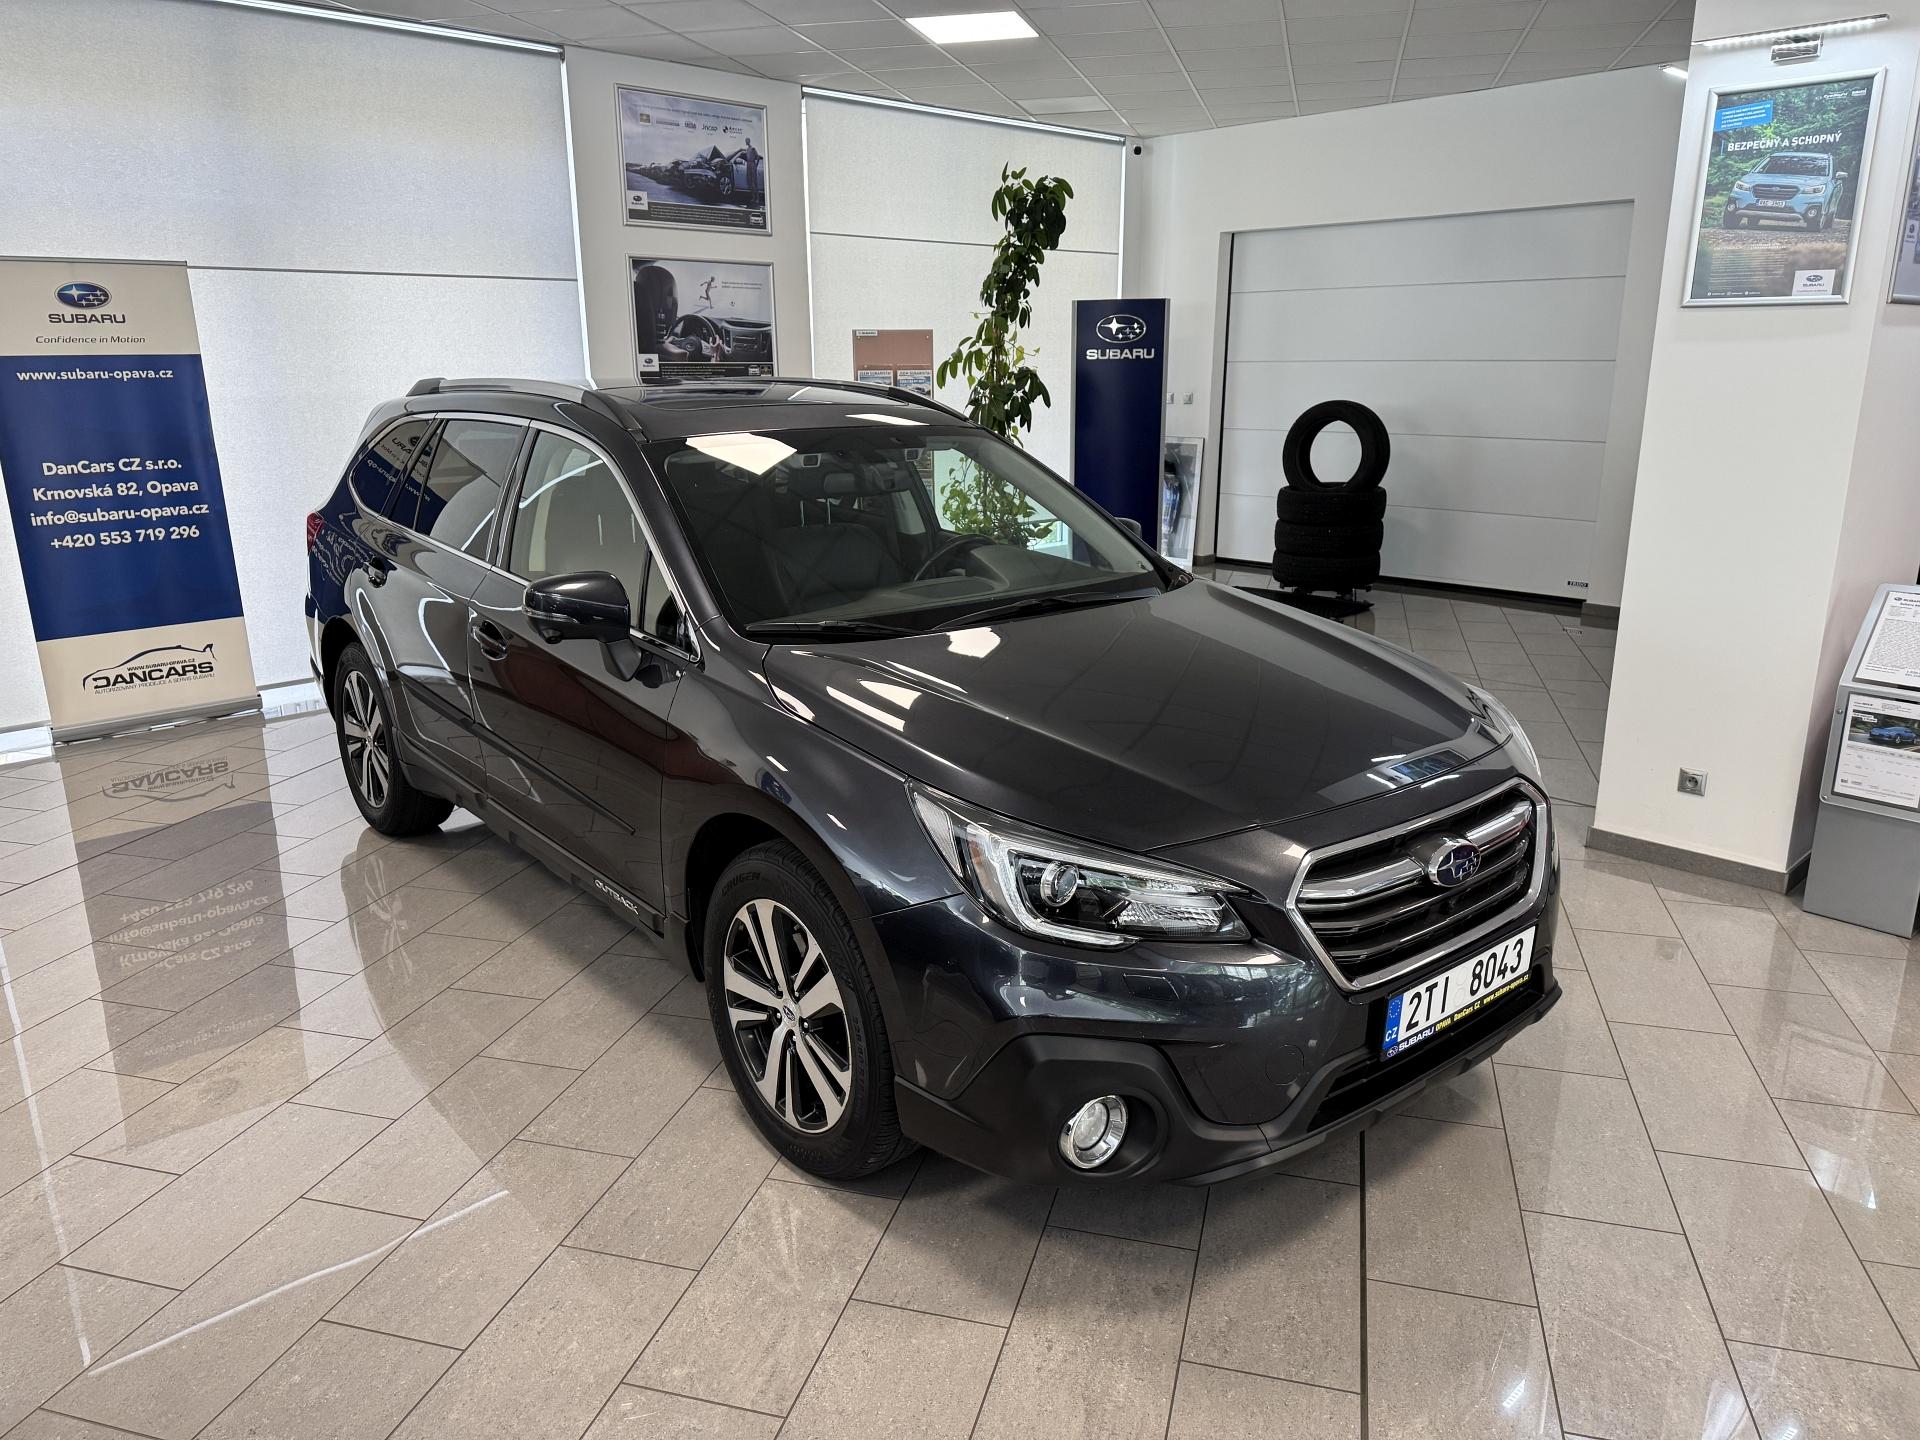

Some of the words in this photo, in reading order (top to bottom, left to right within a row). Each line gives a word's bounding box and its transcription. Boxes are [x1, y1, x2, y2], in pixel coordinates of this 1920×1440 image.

[1727, 136, 1781, 152] BEZPEČNÝ
[1781, 138, 1790, 147] A
[1791, 129, 1842, 146] SCHOPNÝ
[48, 313, 126, 324] SUBARU
[35, 335, 97, 344] Confidence
[99, 335, 108, 344] in
[110, 335, 146, 344] Motion
[1086, 348, 1155, 360] SUBARU
[16, 368, 174, 382] www.subaru-opava.cz
[42, 460, 116, 476] DanCars
[118, 457, 142, 471] CZ
[145, 458, 182, 470] s.r.o.
[33, 483, 113, 501] Krnovská
[117, 482, 143, 497] 82,
[147, 480, 199, 494] Opava
[30, 503, 209, 527] info@subaru-opava.cz
[50, 534, 96, 549] +420
[100, 531, 132, 546] 553
[136, 527, 166, 542] 719
[170, 525, 200, 539] 296
[92, 661, 214, 689] DANCARS
[594, 879, 639, 915] OUTBACK
[1405, 976, 1450, 1033] 2TI
[1469, 937, 1524, 997] 8043
[1385, 1026, 1398, 1042] CZ
[1398, 1027, 1435, 1051] SUBARU
[1474, 1000, 1481, 1010] CZ
